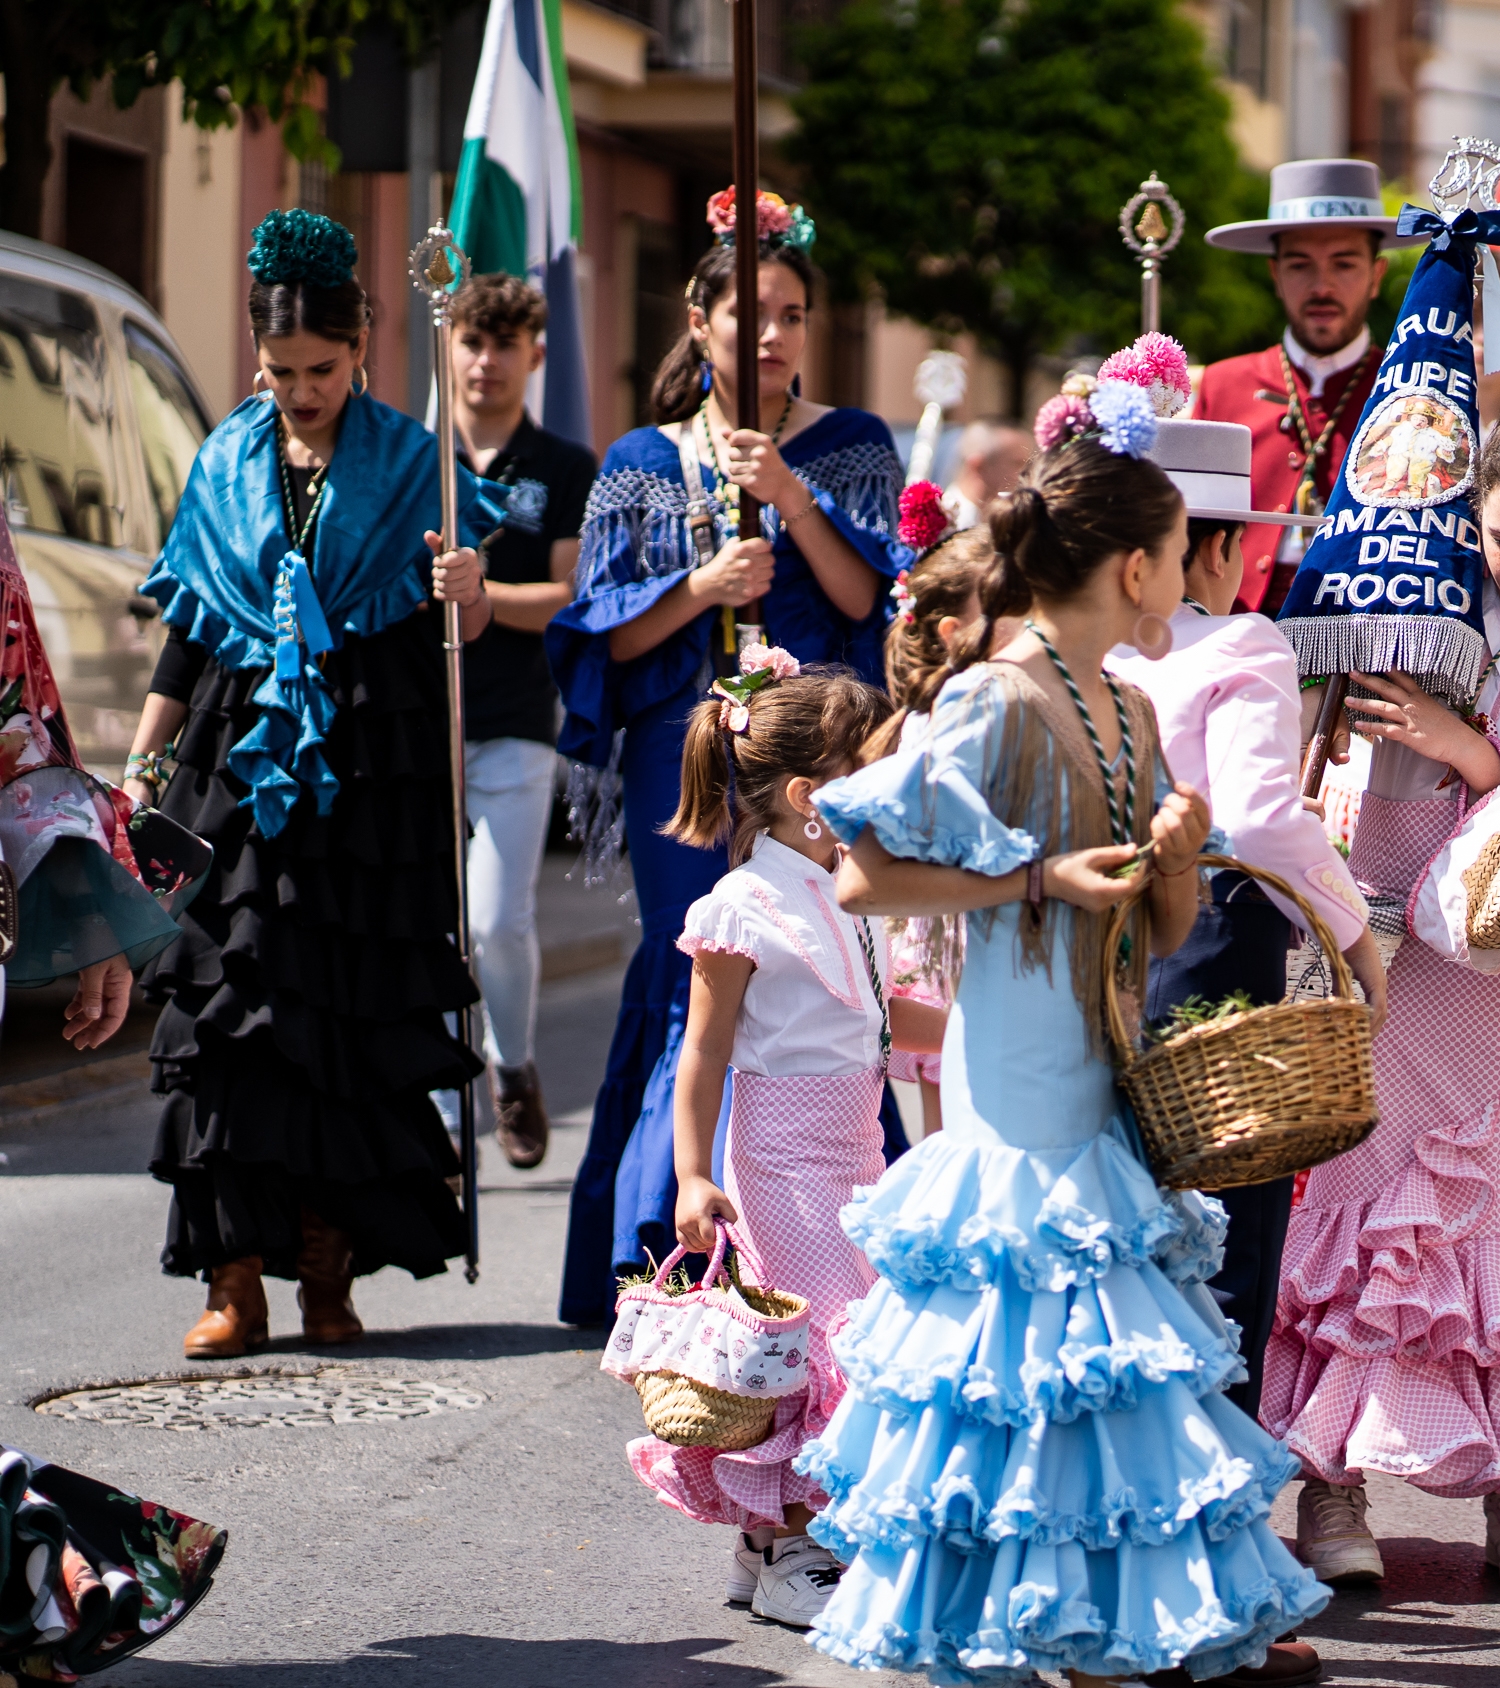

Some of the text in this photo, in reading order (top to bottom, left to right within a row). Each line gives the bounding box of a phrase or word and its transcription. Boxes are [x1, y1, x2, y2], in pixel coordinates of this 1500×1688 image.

[1370, 361, 1479, 411] HUPE
[1358, 534, 1439, 568] DEL
[1313, 572, 1471, 614] ROCIO
